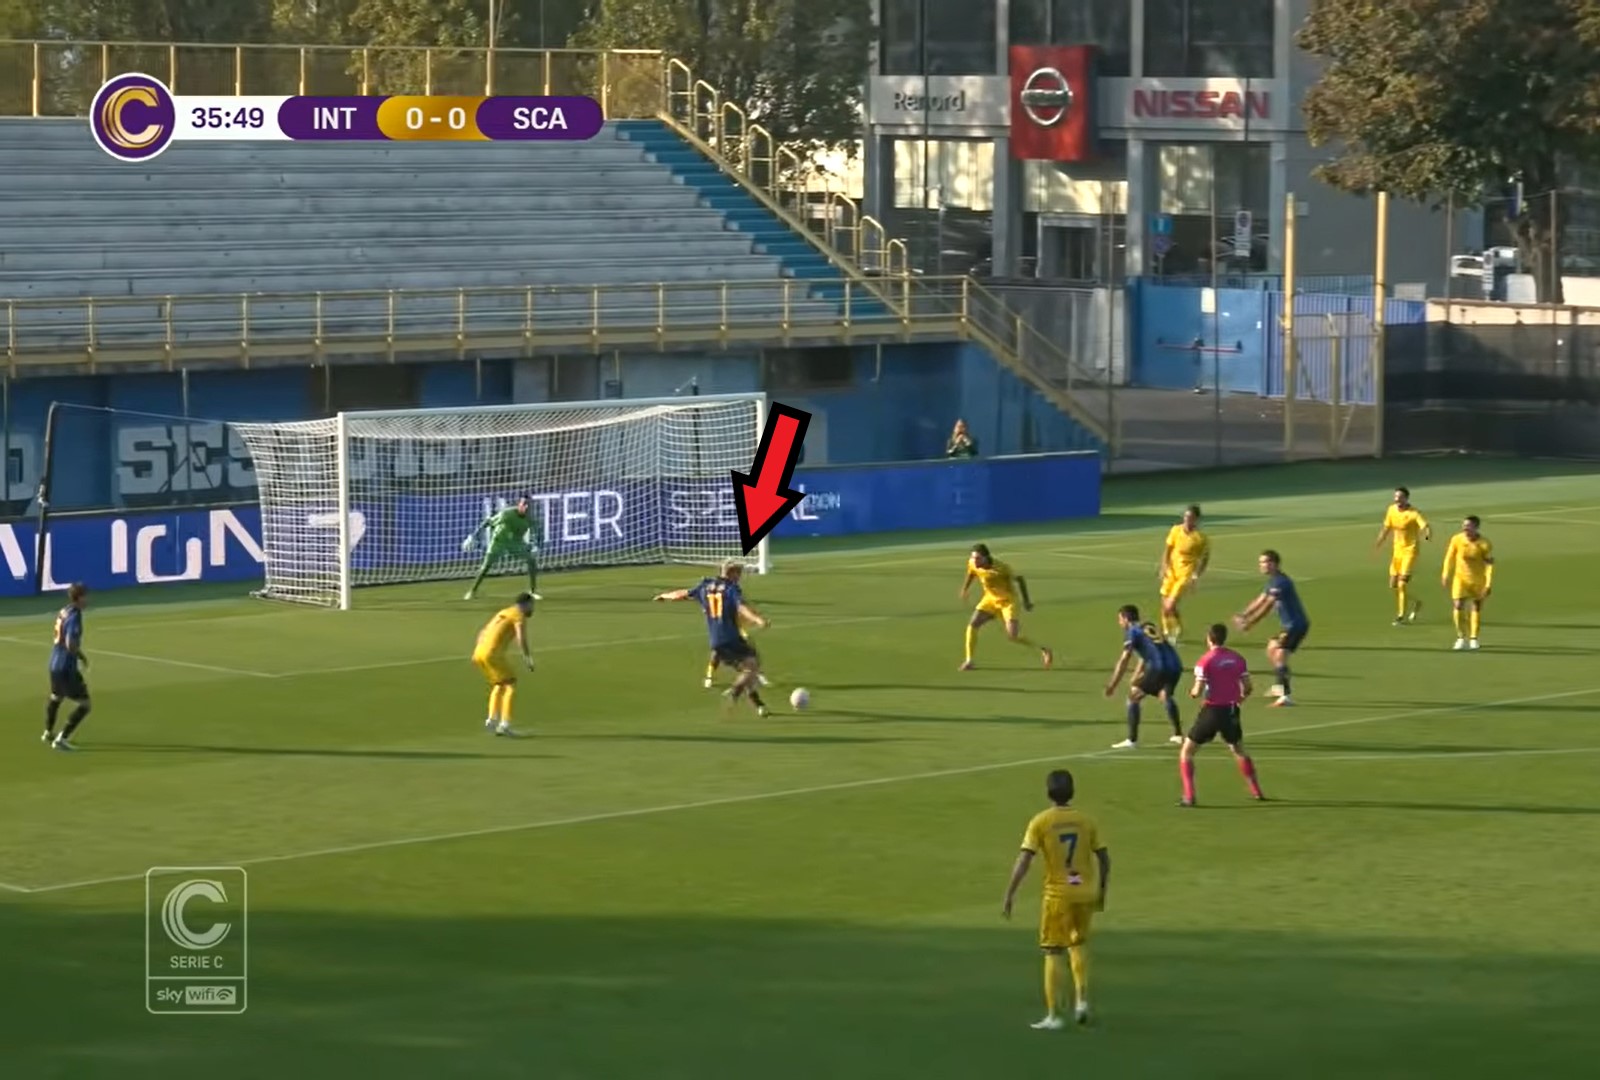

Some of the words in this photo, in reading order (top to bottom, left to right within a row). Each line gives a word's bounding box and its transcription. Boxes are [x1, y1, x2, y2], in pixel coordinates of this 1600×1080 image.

[1133, 89, 1270, 118] NISSAN
[483, 489, 623, 548] ITER
[706, 592, 723, 619] 11
[1058, 833, 1078, 868] 7
